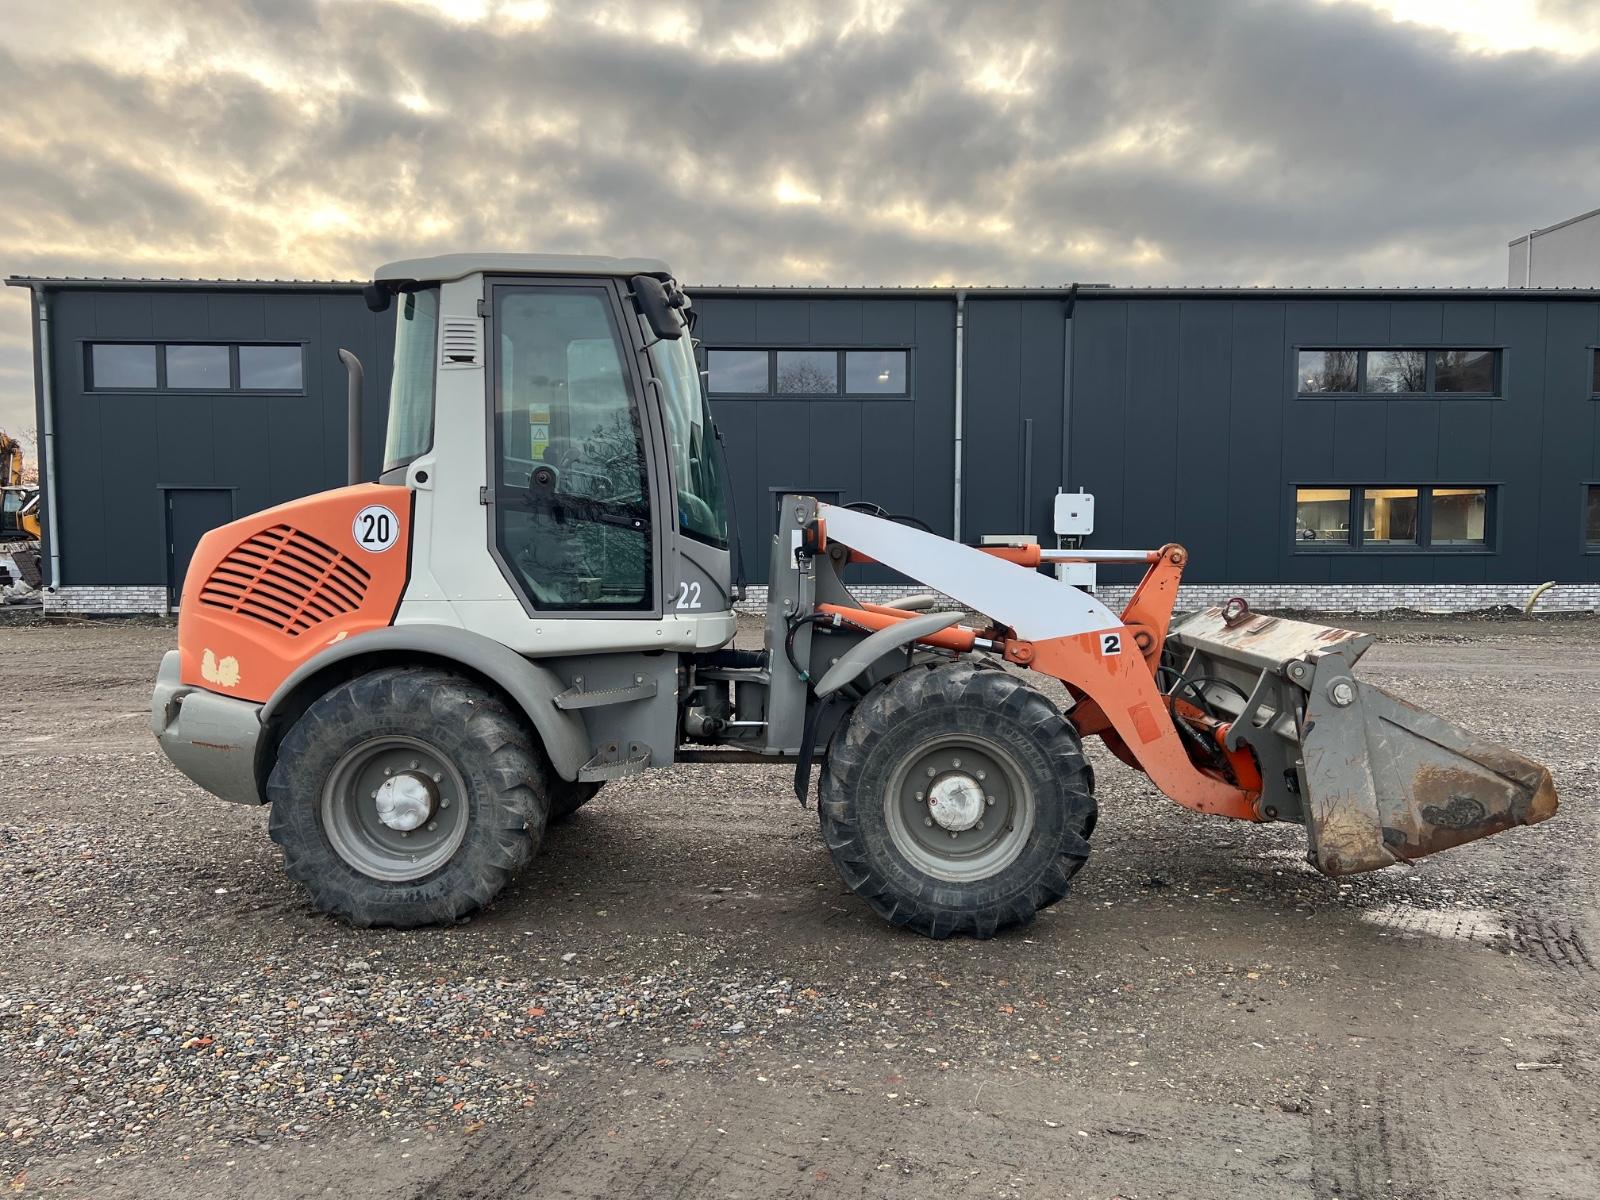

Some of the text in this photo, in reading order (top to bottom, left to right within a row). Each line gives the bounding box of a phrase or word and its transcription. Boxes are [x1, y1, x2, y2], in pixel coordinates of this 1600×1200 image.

[363, 514, 389, 543] 20
[676, 582, 701, 609] 22
[1104, 635, 1120, 653] 2
